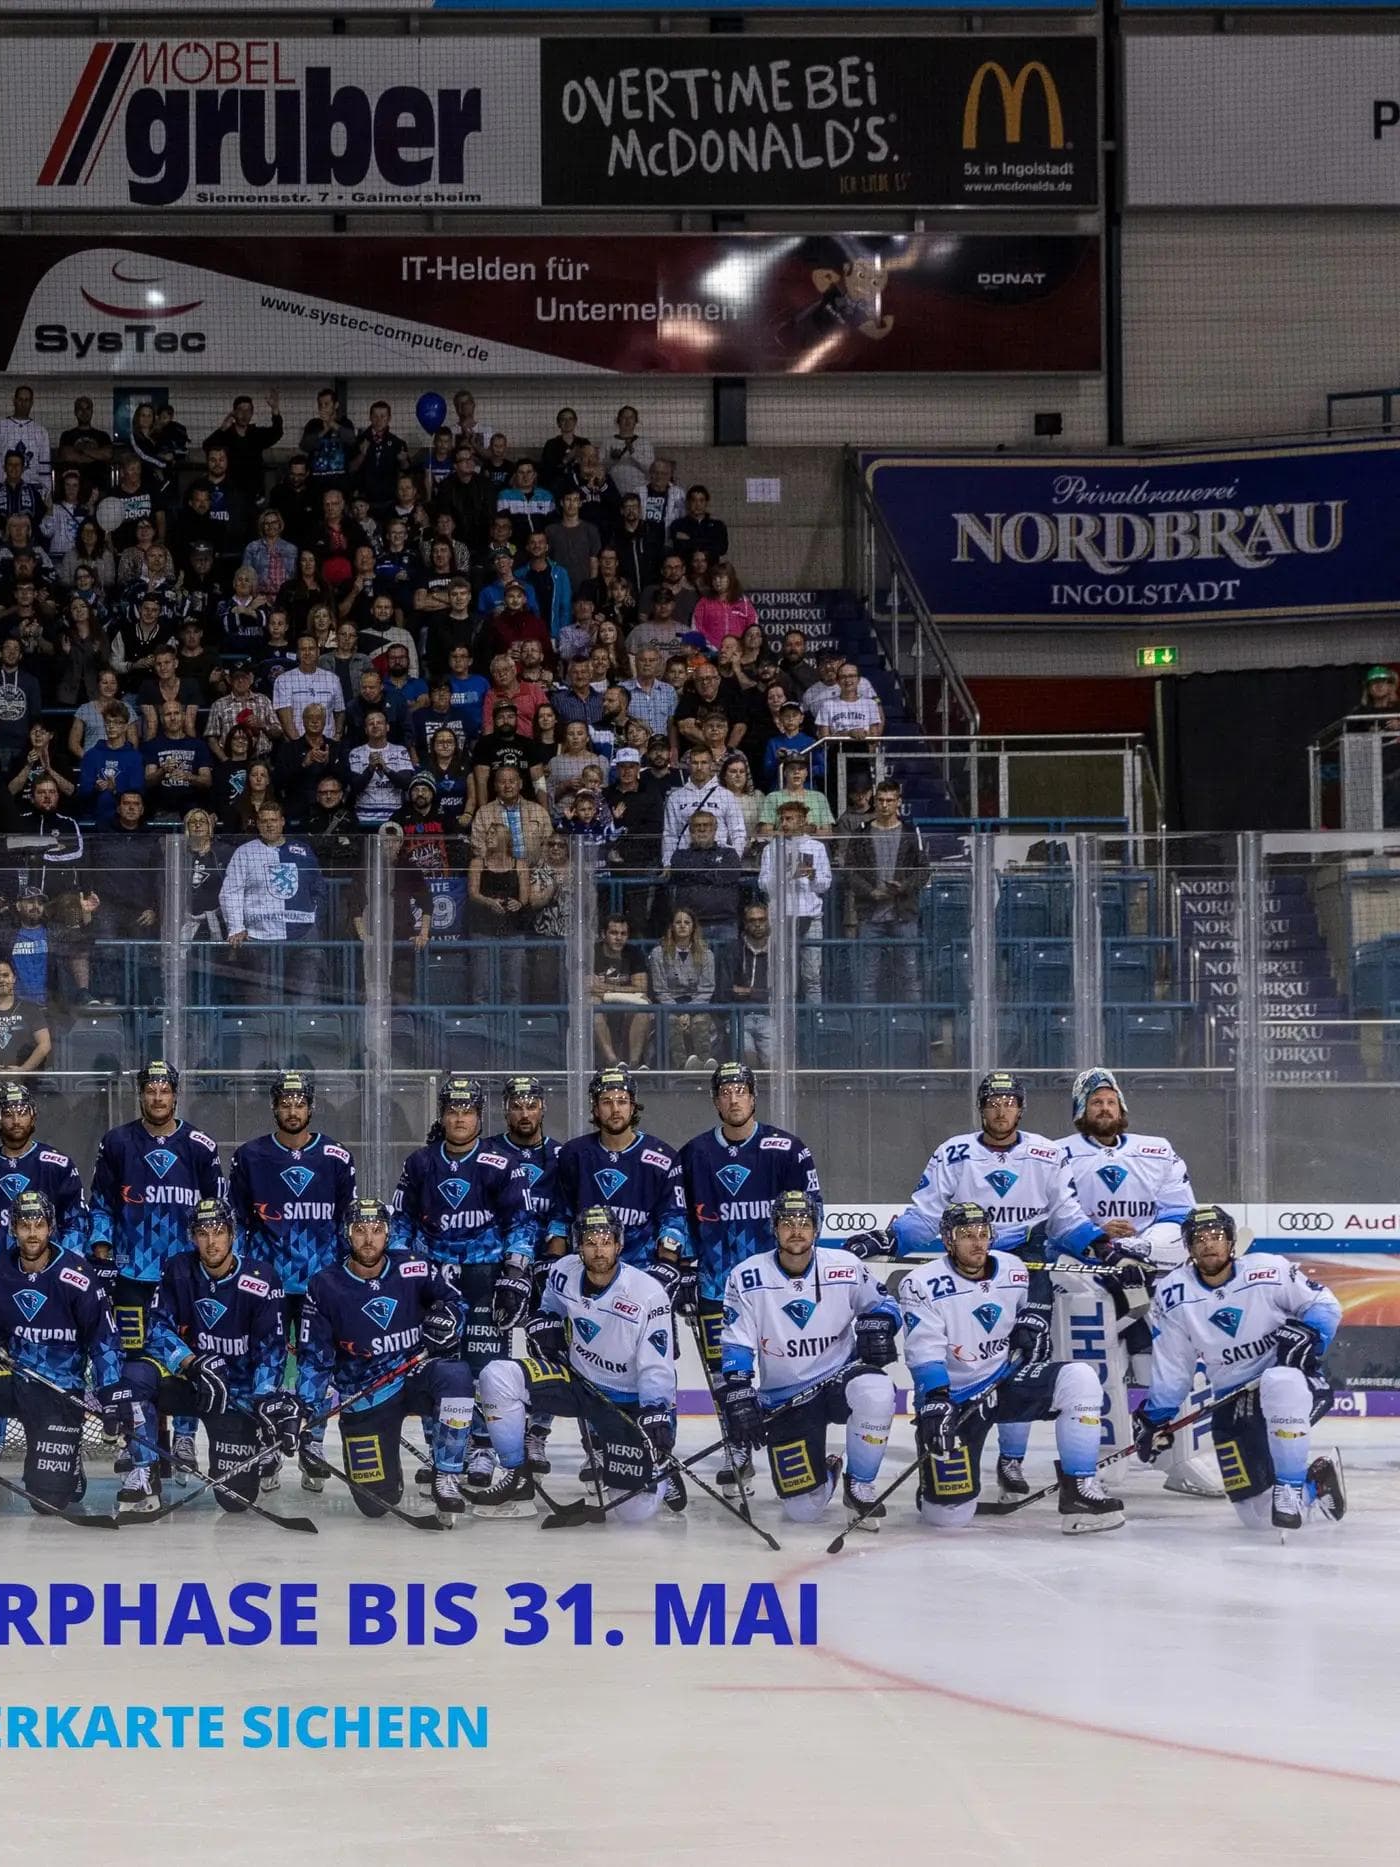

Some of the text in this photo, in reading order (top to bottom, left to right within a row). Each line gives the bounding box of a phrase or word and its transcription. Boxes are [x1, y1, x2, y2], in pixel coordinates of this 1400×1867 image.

[131, 41, 296, 84] MÖBEL
[125, 66, 482, 205] gruber
[964, 161, 1074, 177] 5x in Ingolstadt
[963, 181, 1073, 192] www.mcdonalds.de
[196, 191, 482, 204] Siemensstr. 7 Gaimersheim
[401, 255, 589, 282] IT-Helden für
[977, 273, 1046, 285] DONAT
[536, 297, 738, 323] Unternehmen
[260, 294, 489, 363] www.systec-computer.de
[34, 324, 207, 359] SysTec
[951, 499, 1351, 577] NORDBRÄU
[1049, 578, 1240, 607] INGOLSTADT
[946, 1143, 970, 1164] 22
[741, 1268, 763, 1288] 61
[927, 1275, 957, 1298] 23
[1162, 1283, 1185, 1308] 27
[36, 1440, 75, 1455] HERRN
[215, 1440, 257, 1455] HERRN
[37, 1457, 71, 1473] BRÄU
[353, 1470, 383, 1481] EDEKA
[609, 1461, 643, 1478] BRÄU
